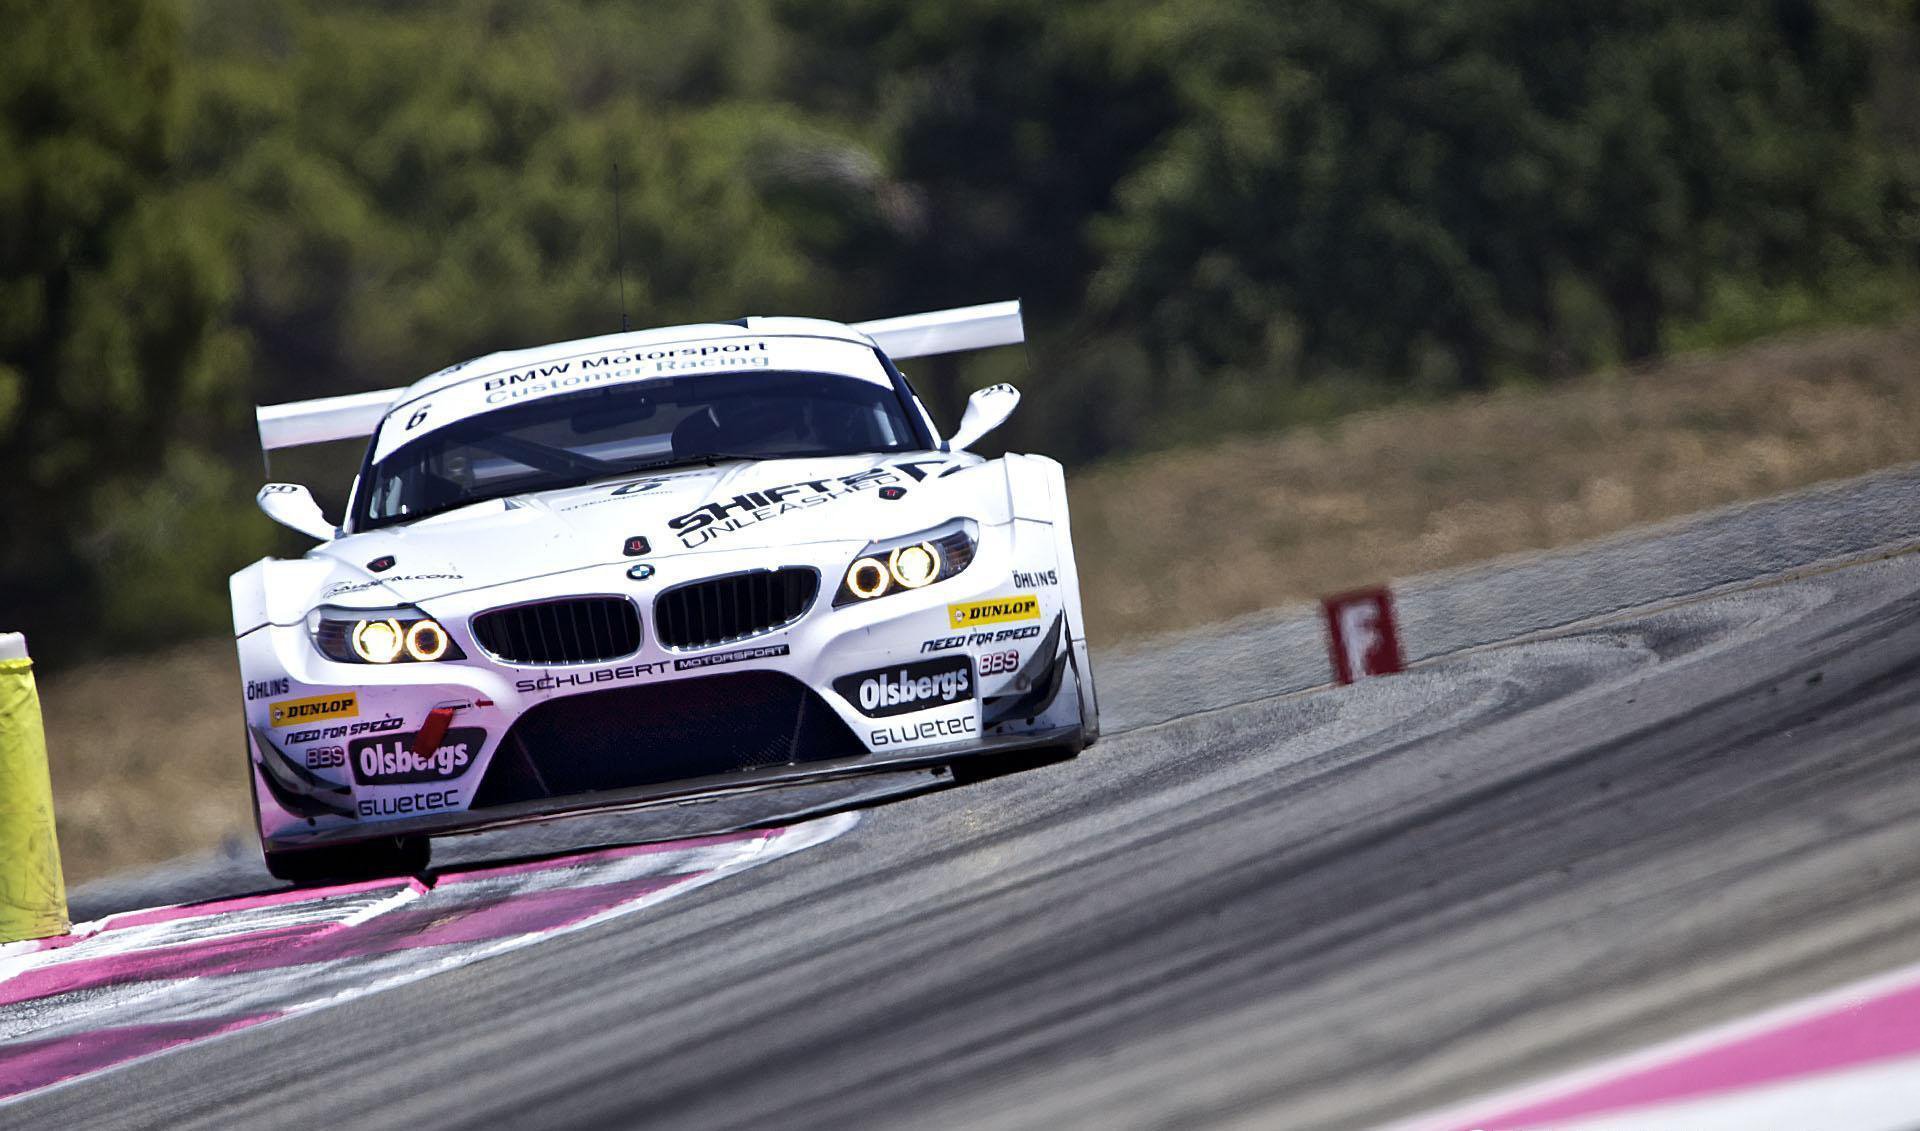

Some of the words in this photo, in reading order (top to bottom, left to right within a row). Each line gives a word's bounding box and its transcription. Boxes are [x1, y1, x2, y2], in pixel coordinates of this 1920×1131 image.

[484, 363, 570, 391] BMW
[582, 342, 768, 370] Motorsport
[485, 366, 643, 404] Customer
[655, 356, 769, 372] Racing
[405, 404, 431, 430] 6
[667, 478, 831, 537] SHIFT
[682, 476, 900, 549] UNLEASHED
[1012, 570, 1058, 588] ÖHLINS
[969, 601, 1035, 620] DUNLOP
[921, 636, 966, 653] NEED
[967, 632, 994, 646] FOR
[995, 625, 1041, 642] SPEED
[1340, 602, 1379, 680] F
[516, 661, 670, 693] SCHUBERT
[679, 645, 786, 670] MOTORSPORT
[979, 650, 1019, 676] BBS
[247, 677, 289, 700] ÖHLINS
[859, 668, 968, 710] Olsbergs
[287, 699, 354, 718] DUNLOP
[285, 730, 321, 745] NEED
[322, 725, 347, 740] FOR
[349, 717, 404, 735] SPEED
[306, 747, 345, 770] BBS
